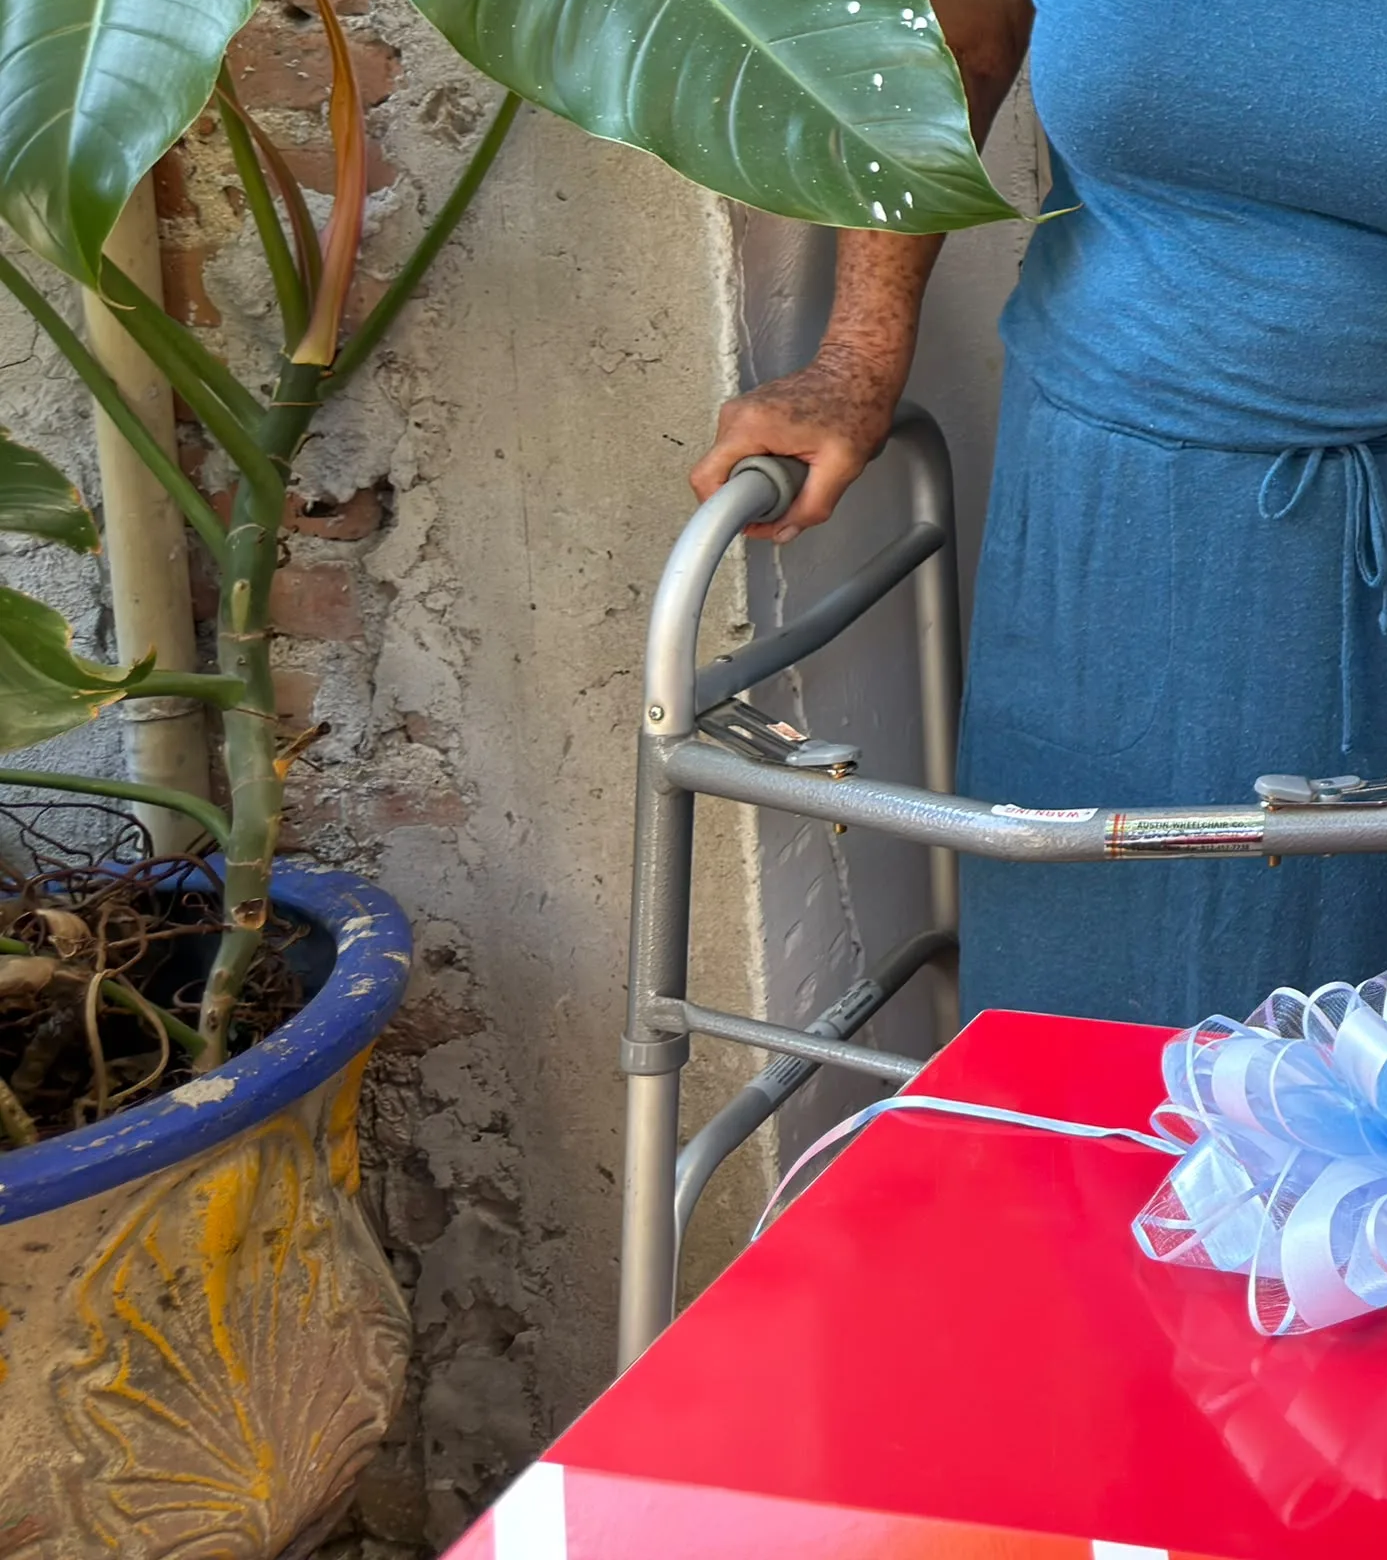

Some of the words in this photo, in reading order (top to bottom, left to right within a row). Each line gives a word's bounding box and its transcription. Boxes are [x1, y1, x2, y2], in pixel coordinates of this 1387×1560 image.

[1004, 807, 1080, 818] WARNING
[1137, 822, 1169, 830] AUSTIN
[1172, 822, 1229, 830] WHEELCHAIR
